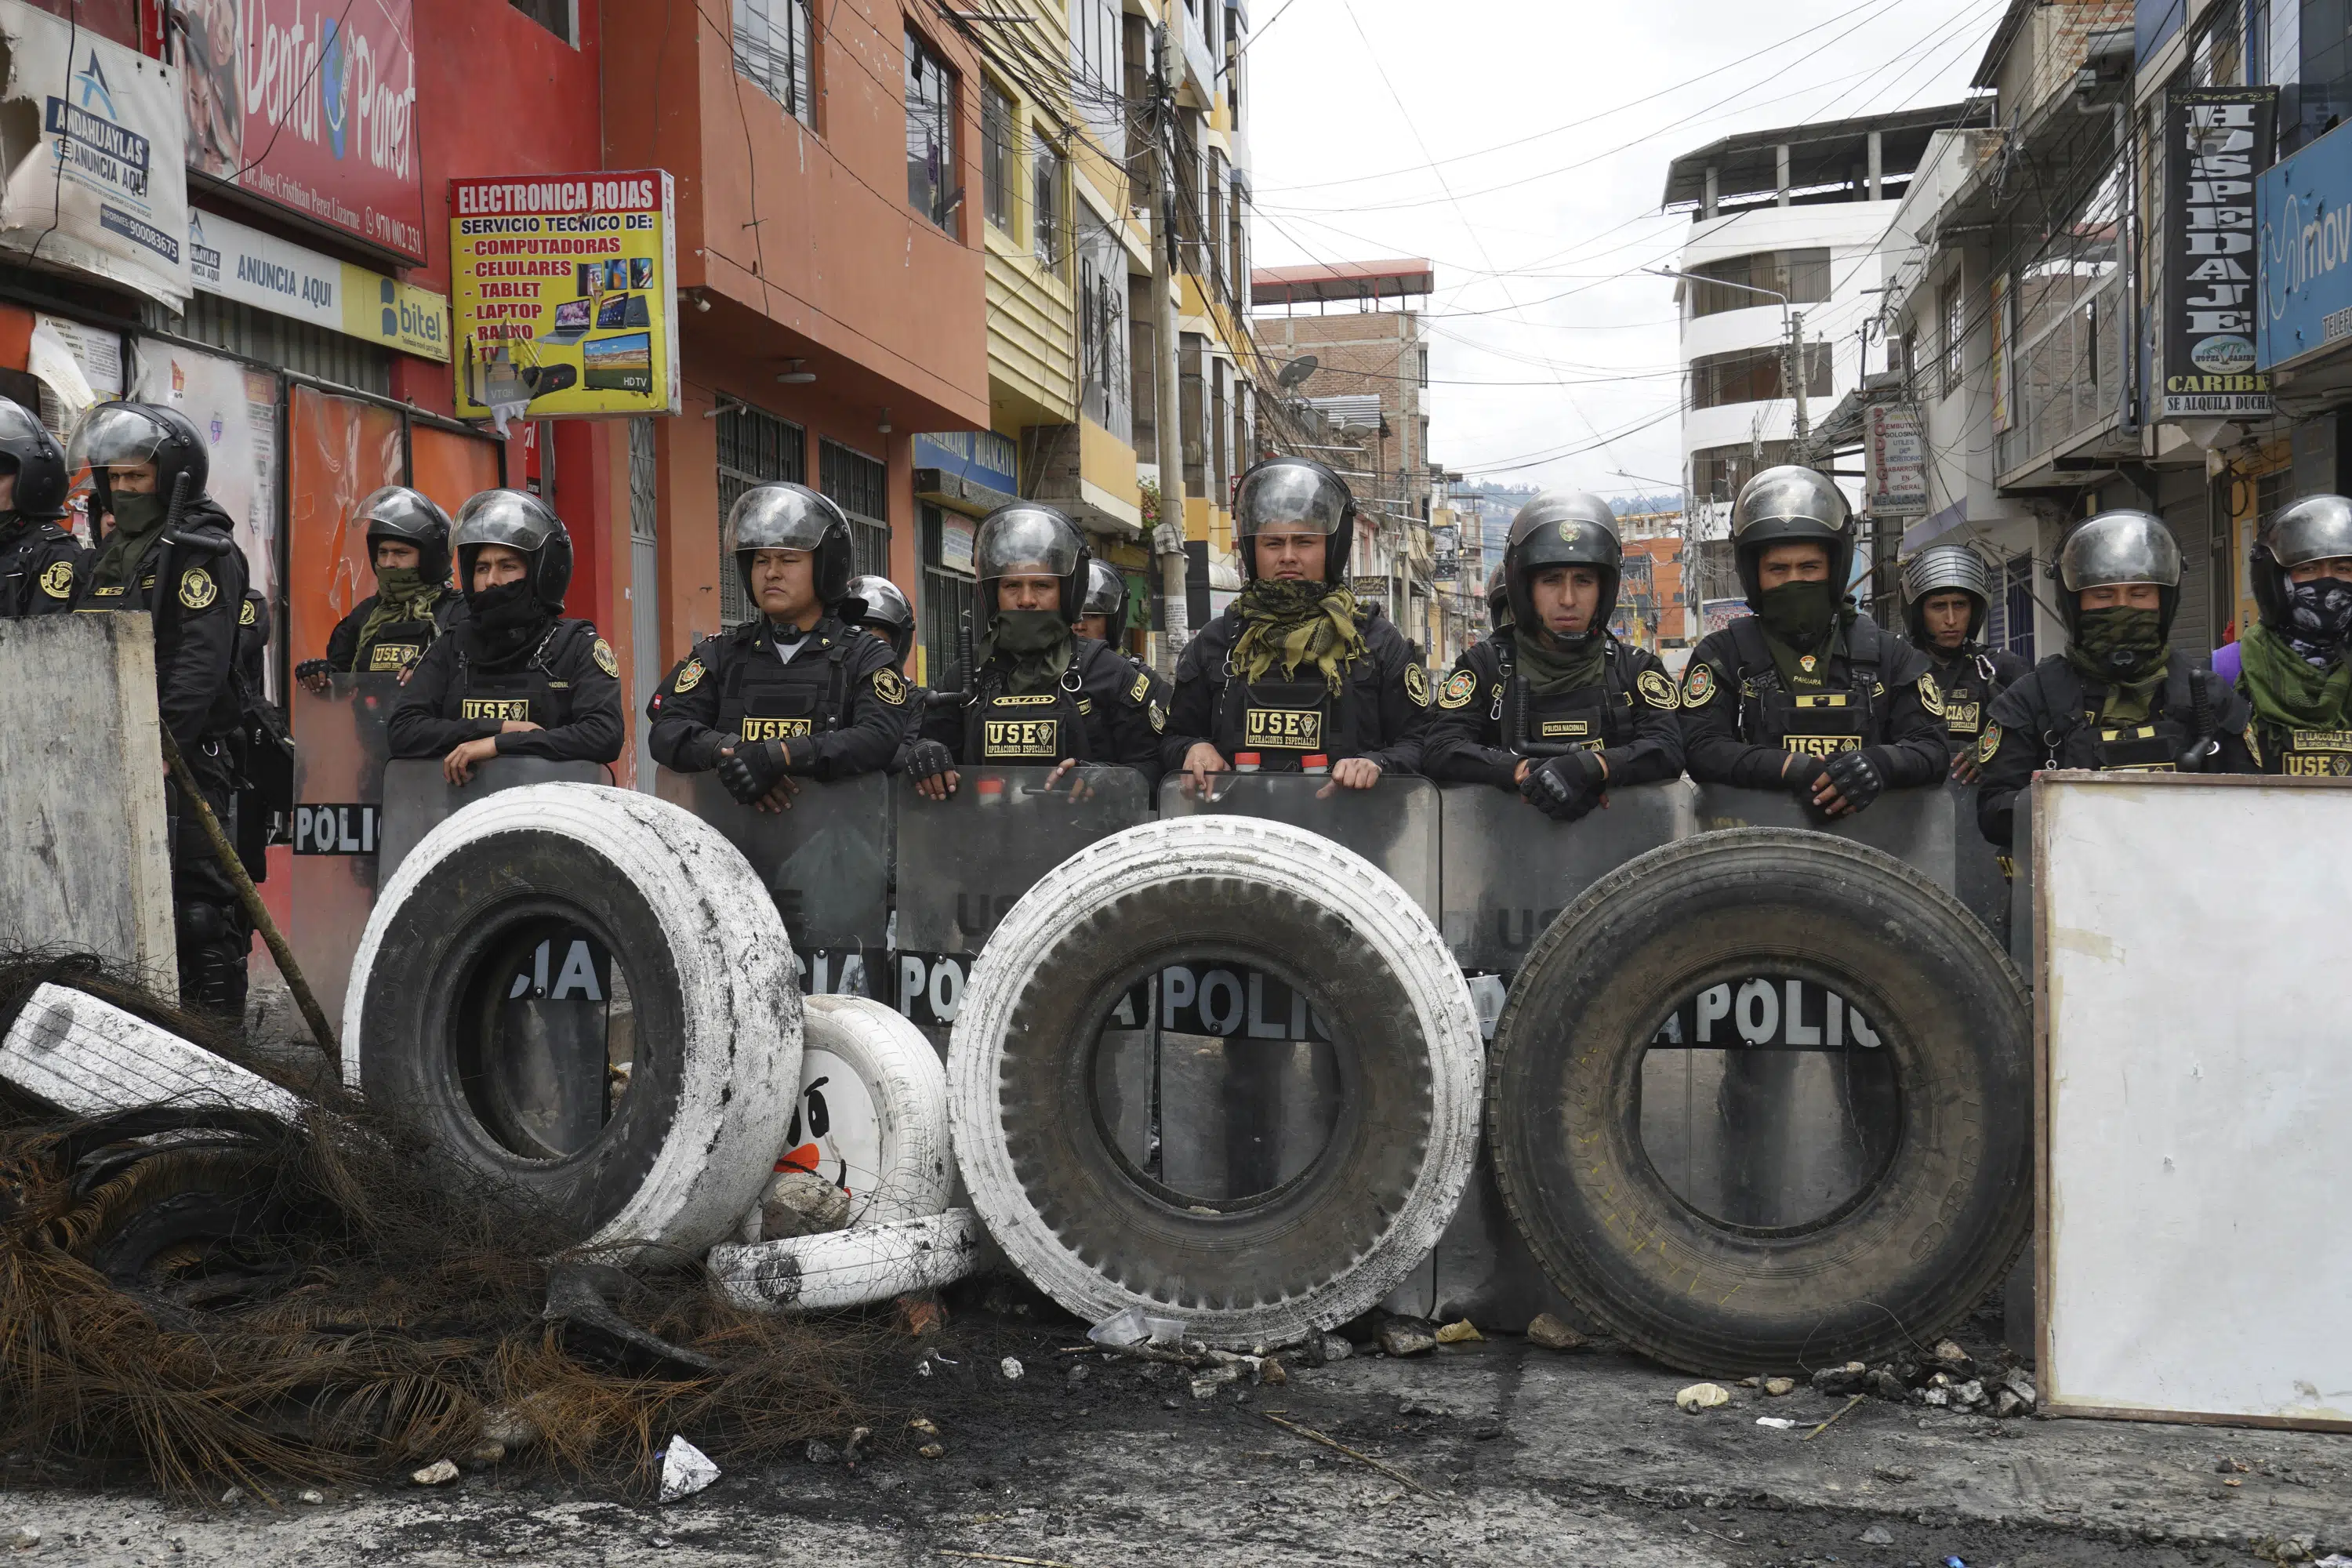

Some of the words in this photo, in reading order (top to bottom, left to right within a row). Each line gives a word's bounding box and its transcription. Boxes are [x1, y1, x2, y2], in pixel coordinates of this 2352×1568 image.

[247, 0, 319, 147] Dental
[356, 34, 416, 183] Planet
[56, 103, 143, 165] ANDAHUAYLAS
[74, 144, 118, 184] ANUNCIA
[245, 158, 257, 187] Dr.
[259, 165, 274, 194] Jose
[277, 172, 310, 209] Cristhian
[311, 187, 331, 219] Perez
[332, 197, 360, 230] Lizarme
[376, 212, 390, 242] 970
[408, 226, 421, 255] 231
[459, 182, 587, 214] ELECTRONICA
[592, 180, 654, 210] ROJAS
[461, 217, 540, 235] SERVICIO
[545, 215, 620, 233] TECNICO
[626, 214, 653, 230] DE:
[129, 220, 177, 259] 900083675
[474, 237, 621, 256] COMPUTADORAS
[475, 260, 572, 278] CELULARES
[237, 254, 296, 297] ANUNCIA
[302, 275, 332, 309] AQUI
[479, 281, 541, 299] TABLET
[400, 299, 441, 343] bitel
[476, 303, 543, 320] LAPTOP
[479, 347, 499, 362] TV
[623, 377, 648, 387] HDTV
[2167, 375, 2270, 393] CARIBE
[2168, 397, 2180, 411] SE
[2183, 396, 2231, 412] ALQUILA
[975, 430, 1015, 478] HUANCAYO
[1874, 407, 1889, 495] BODEGA
[375, 647, 401, 662] USE
[466, 702, 510, 719] USE
[1250, 712, 1299, 735] USE
[1544, 724, 1562, 733] POLICIA
[1562, 724, 1585, 733] NACIONAL
[989, 724, 1036, 744] USE
[1248, 734, 1283, 746] OPERACIONES
[1284, 736, 1316, 746] ESPECIALES
[2298, 732, 2304, 741] J.
[988, 745, 1021, 753] OPERACIONES
[1022, 745, 1053, 753] ESPECIALES
[2288, 756, 2331, 777] USE
[297, 807, 381, 851] POLI
[901, 955, 977, 1022] PO
